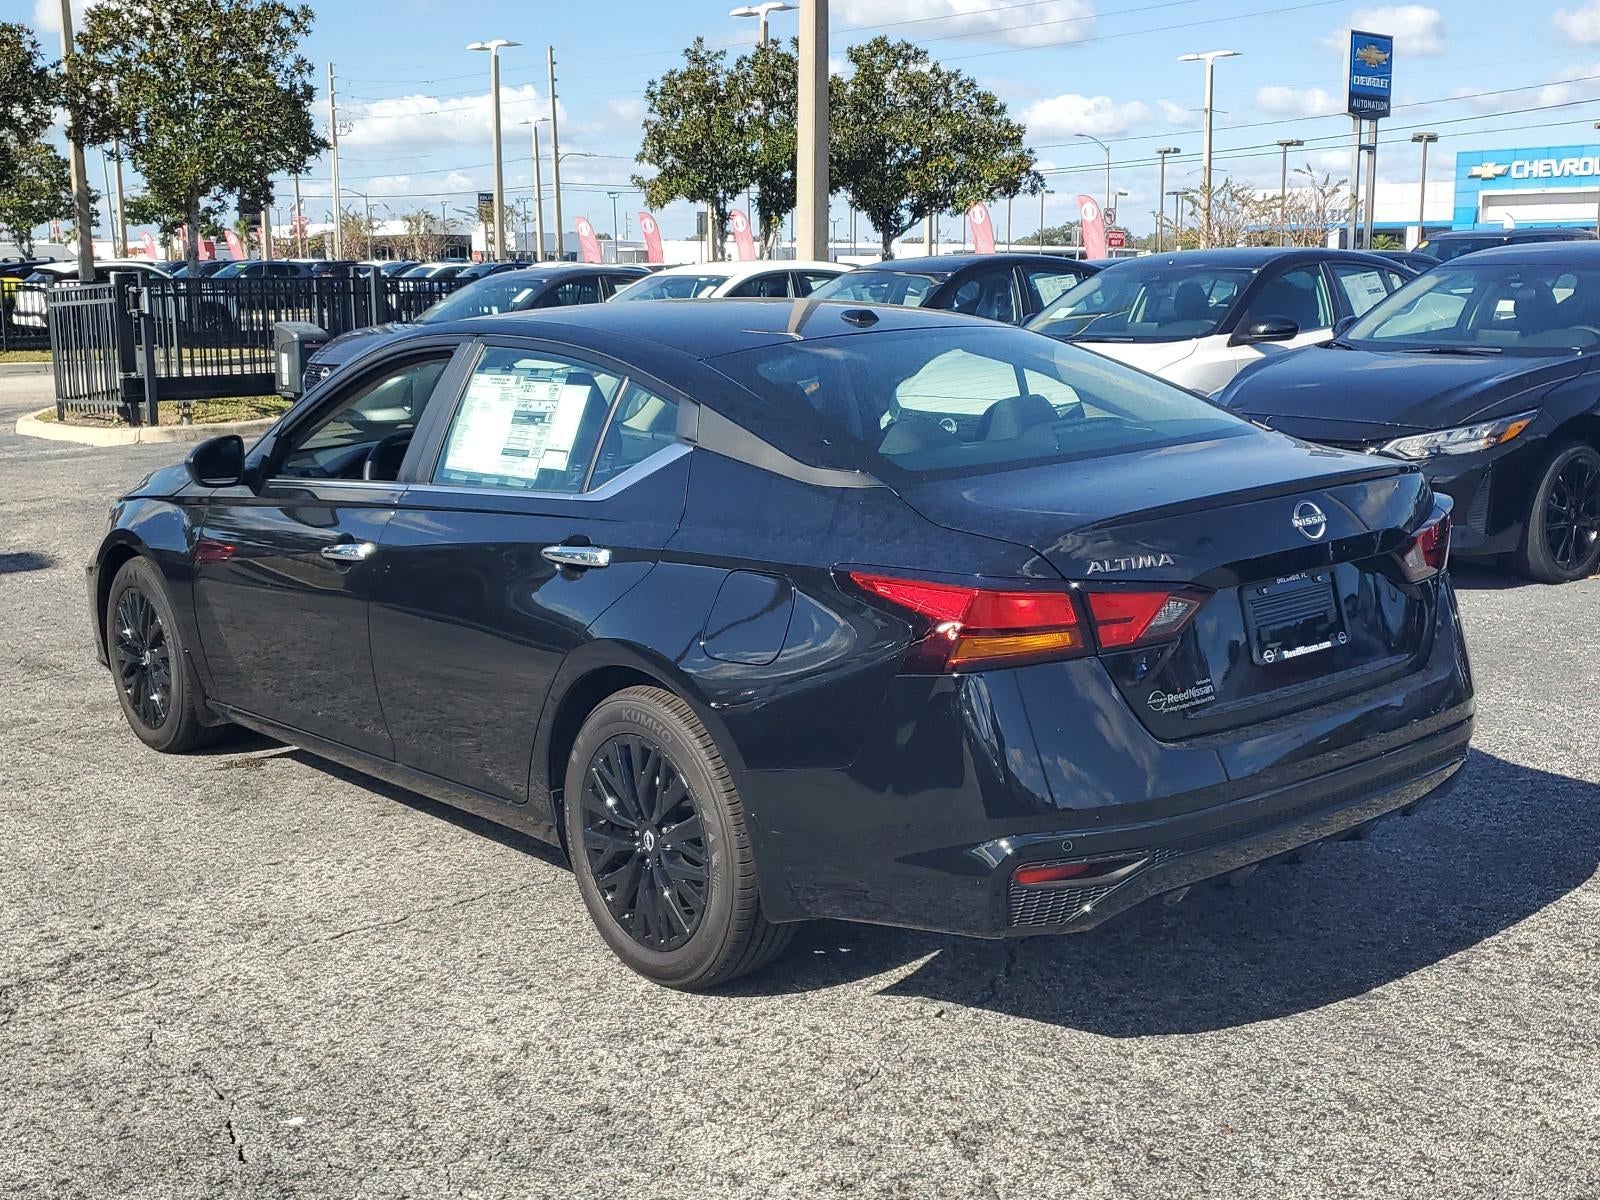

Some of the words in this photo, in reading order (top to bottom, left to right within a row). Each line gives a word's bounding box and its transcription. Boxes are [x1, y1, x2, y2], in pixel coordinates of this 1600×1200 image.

[1352, 98, 1389, 111] AUTONATION
[1292, 513, 1327, 528] NISSAN
[1086, 553, 1175, 575] ALTIMA
[1282, 640, 1332, 659] ReedNissan.com
[622, 708, 672, 744] KUMHO
